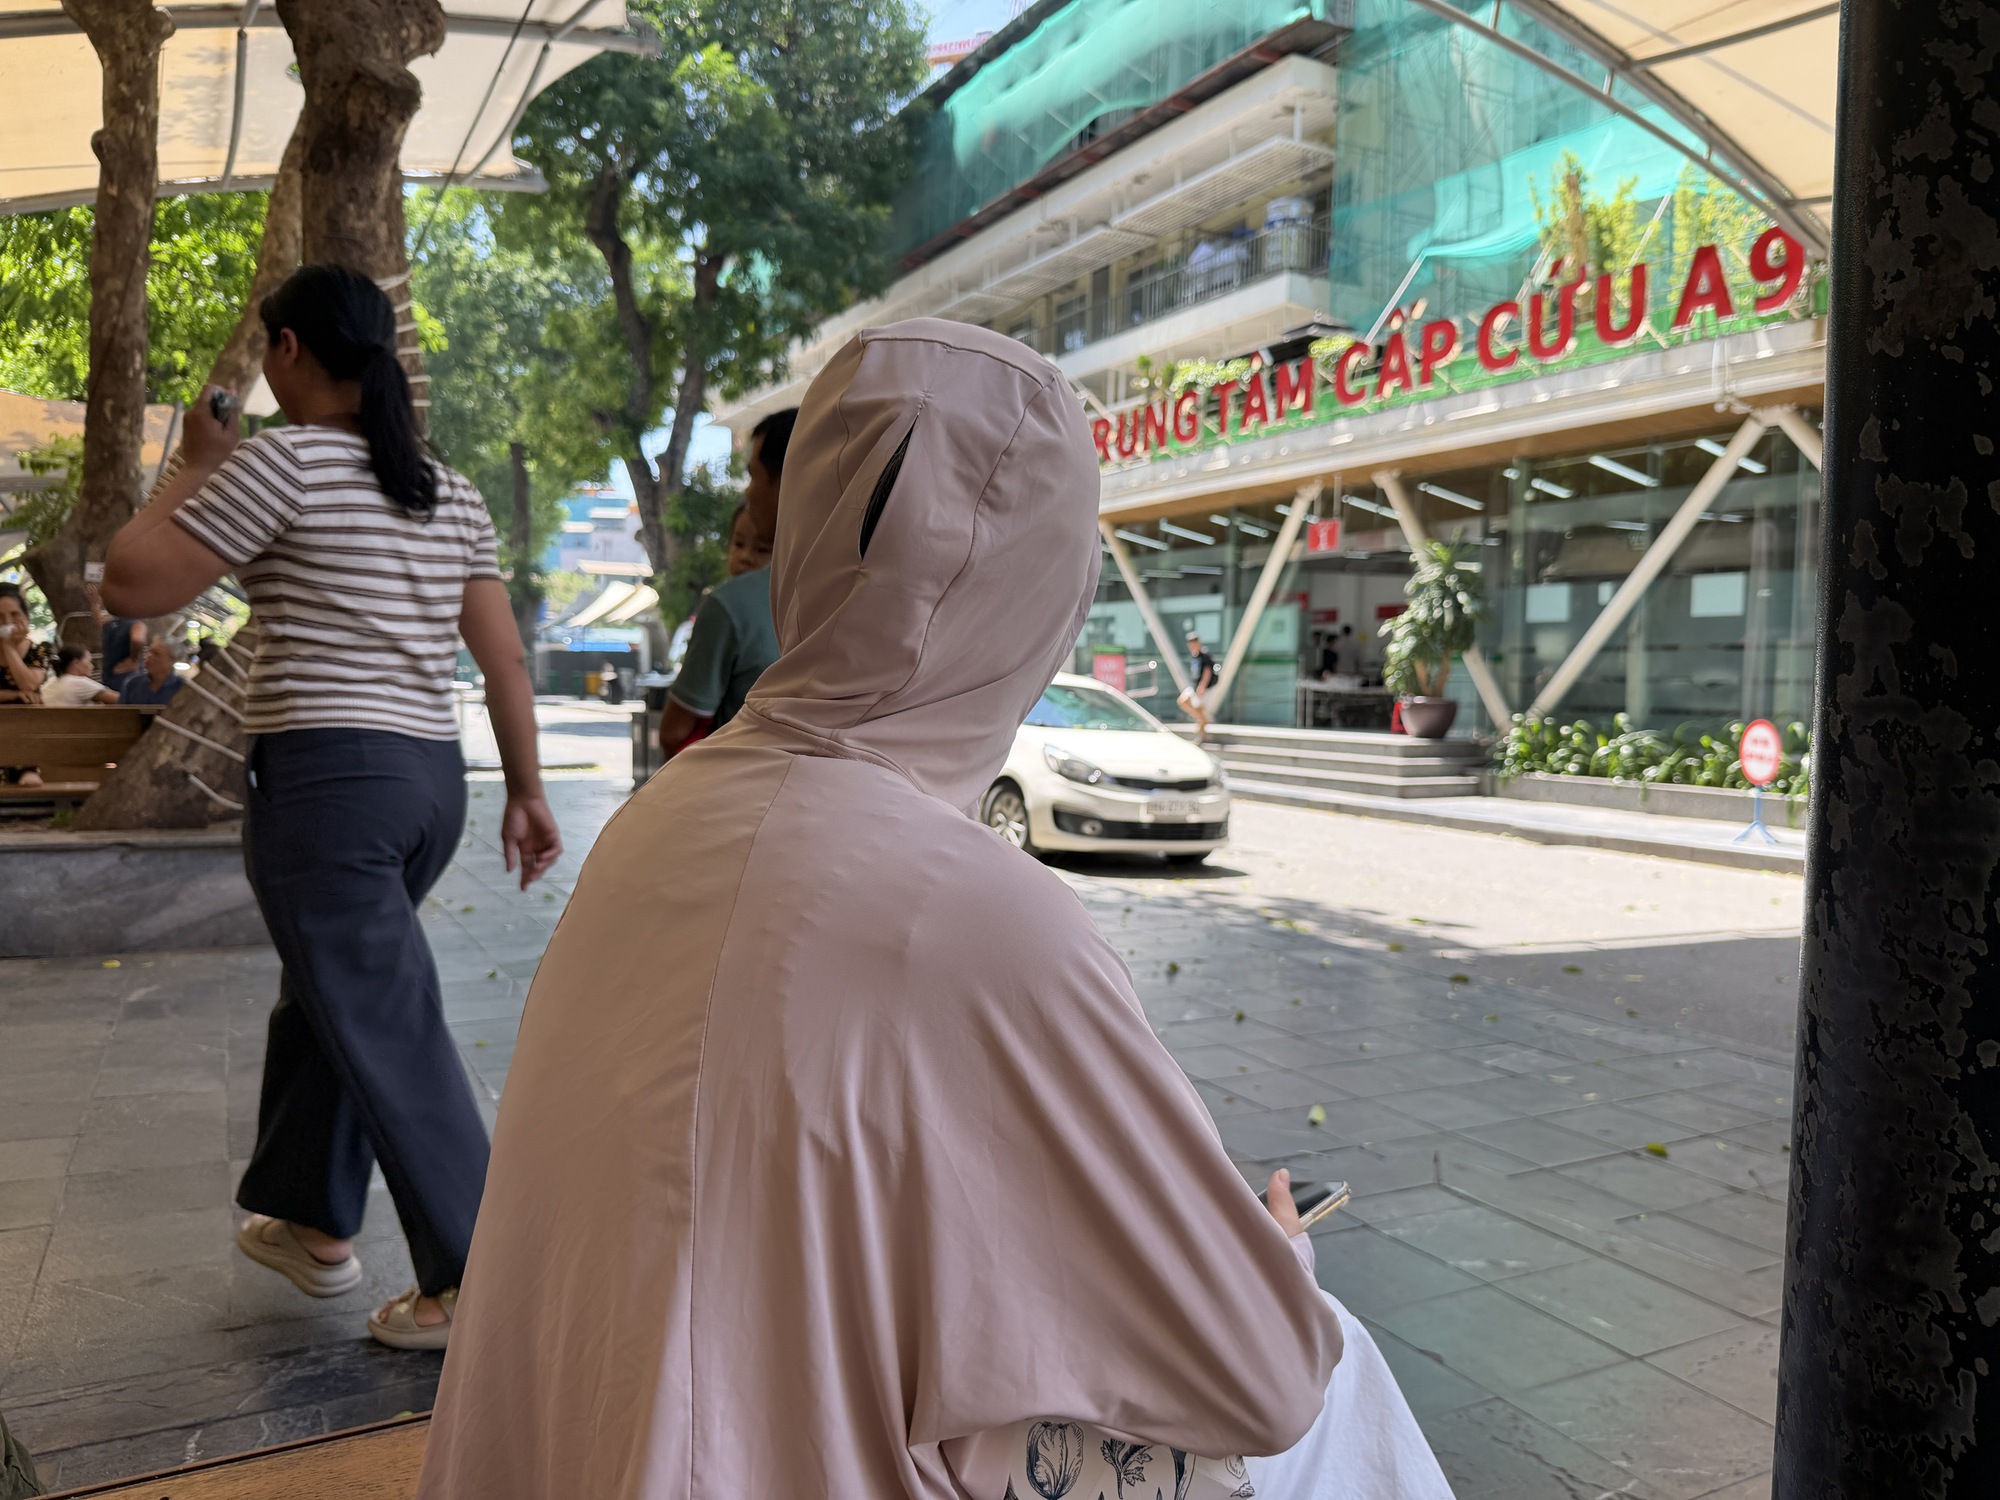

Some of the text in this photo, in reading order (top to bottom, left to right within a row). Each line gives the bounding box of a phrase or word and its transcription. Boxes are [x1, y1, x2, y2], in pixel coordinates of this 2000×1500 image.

[1093, 381, 1199, 461] RUNG
[1213, 351, 1315, 436] TÂM
[1335, 299, 1458, 405] CẤP
